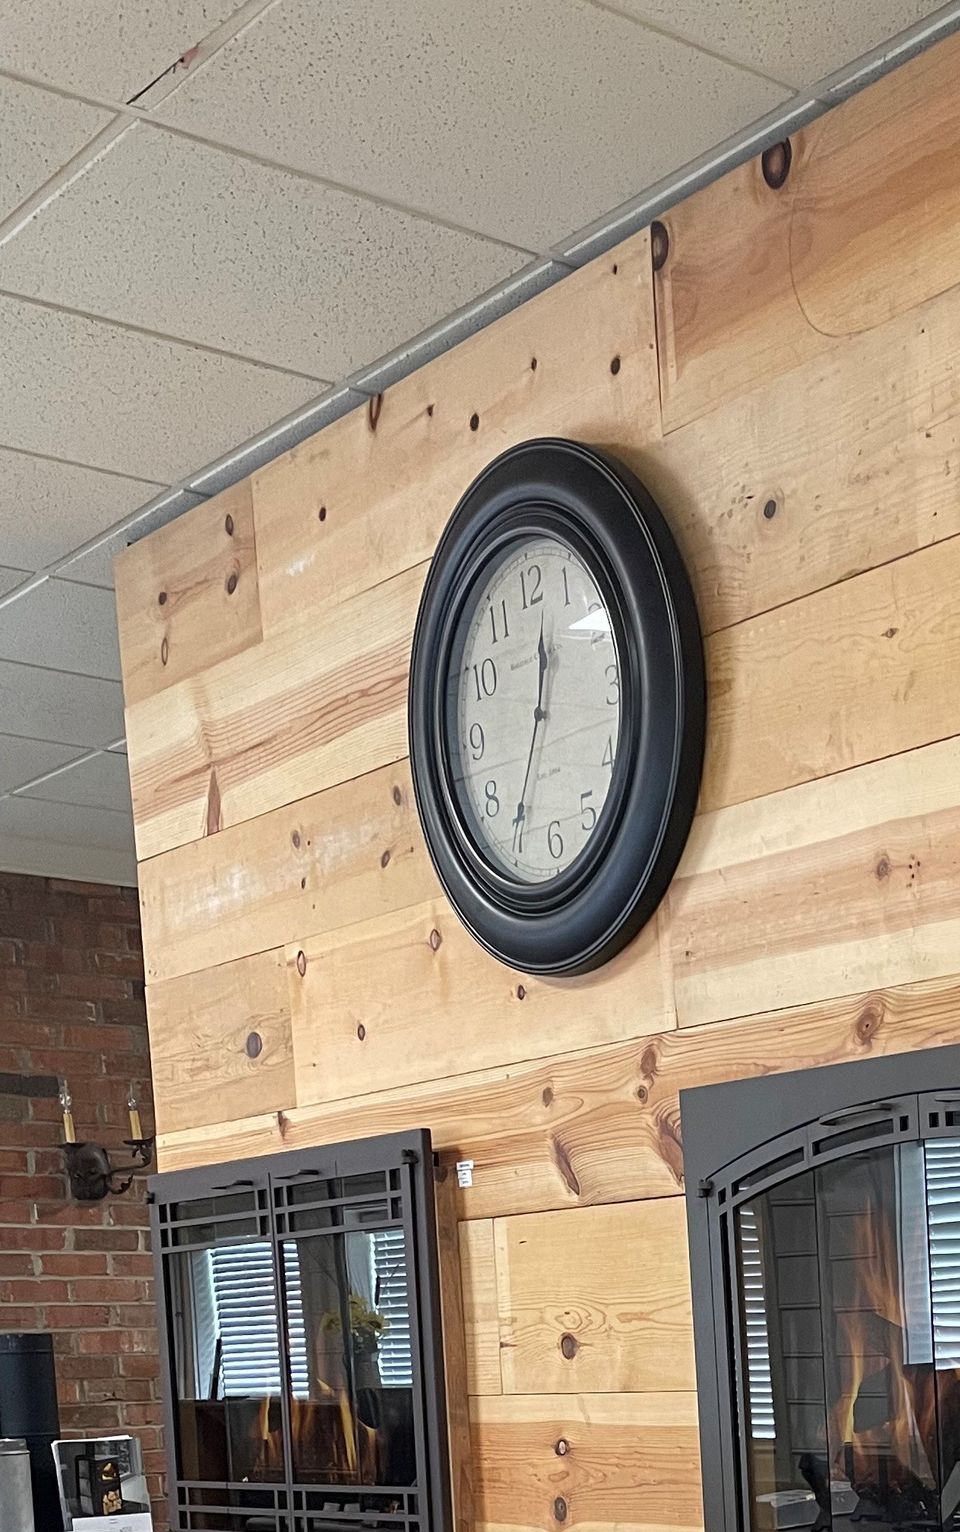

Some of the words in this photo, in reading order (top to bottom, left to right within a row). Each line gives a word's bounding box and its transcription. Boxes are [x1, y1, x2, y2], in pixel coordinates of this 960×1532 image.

[519, 564, 544, 610] 12
[561, 565, 571, 608] 1
[489, 600, 510, 645] 11
[473, 658, 497, 702] 10
[604, 664, 619, 706] 3
[469, 722, 485, 761] 9
[601, 734, 615, 775] 4
[484, 780, 500, 818] 8
[580, 789, 597, 831] 5
[547, 820, 564, 859] 6
